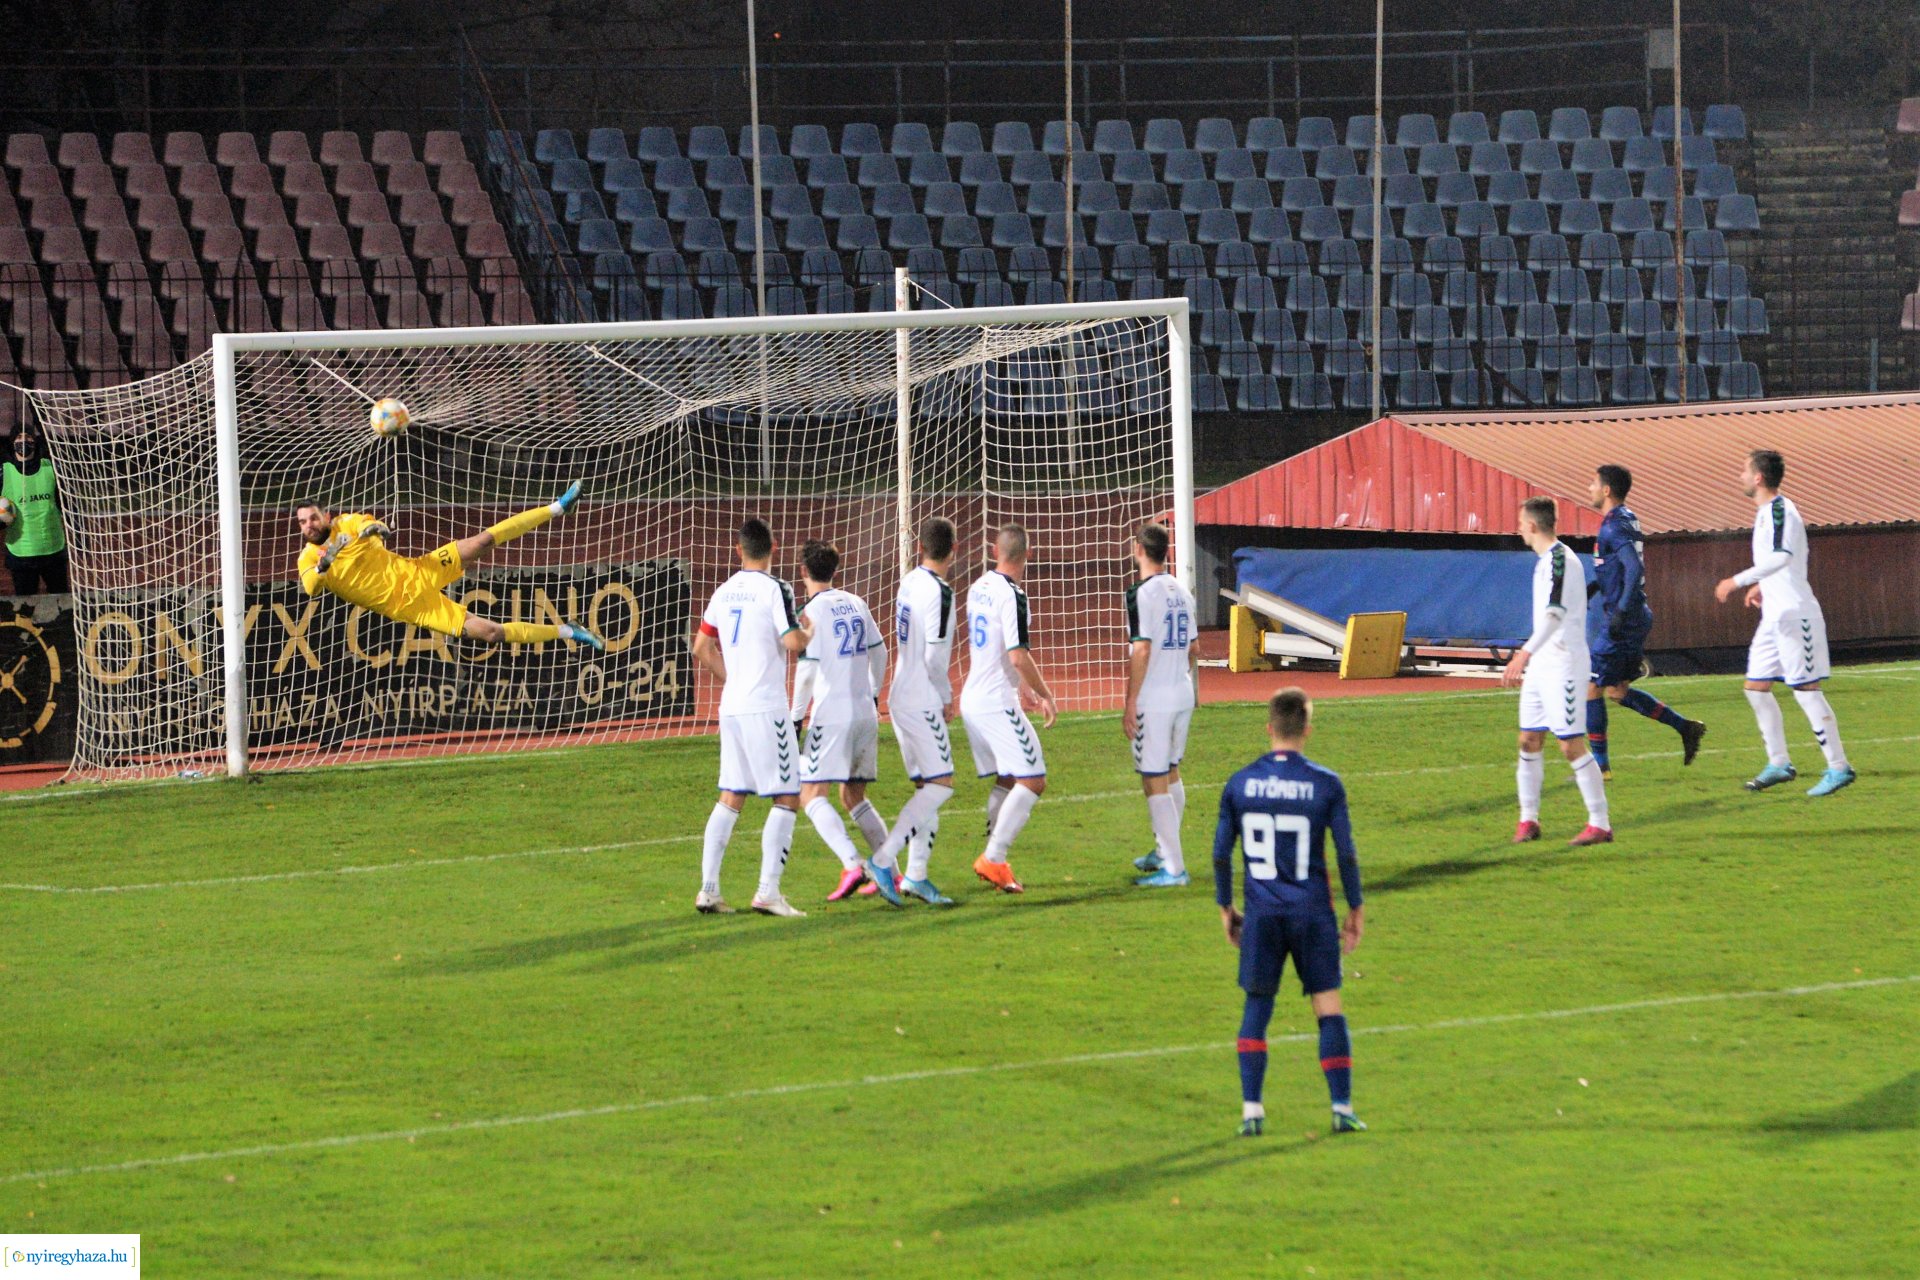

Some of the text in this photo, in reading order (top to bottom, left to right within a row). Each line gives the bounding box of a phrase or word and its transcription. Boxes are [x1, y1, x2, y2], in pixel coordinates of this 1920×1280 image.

[30, 493, 51, 503] JAKO
[729, 606, 743, 647] 7
[833, 616, 867, 659] 22
[578, 660, 681, 705] 0-24
[1242, 812, 1311, 880] 97
